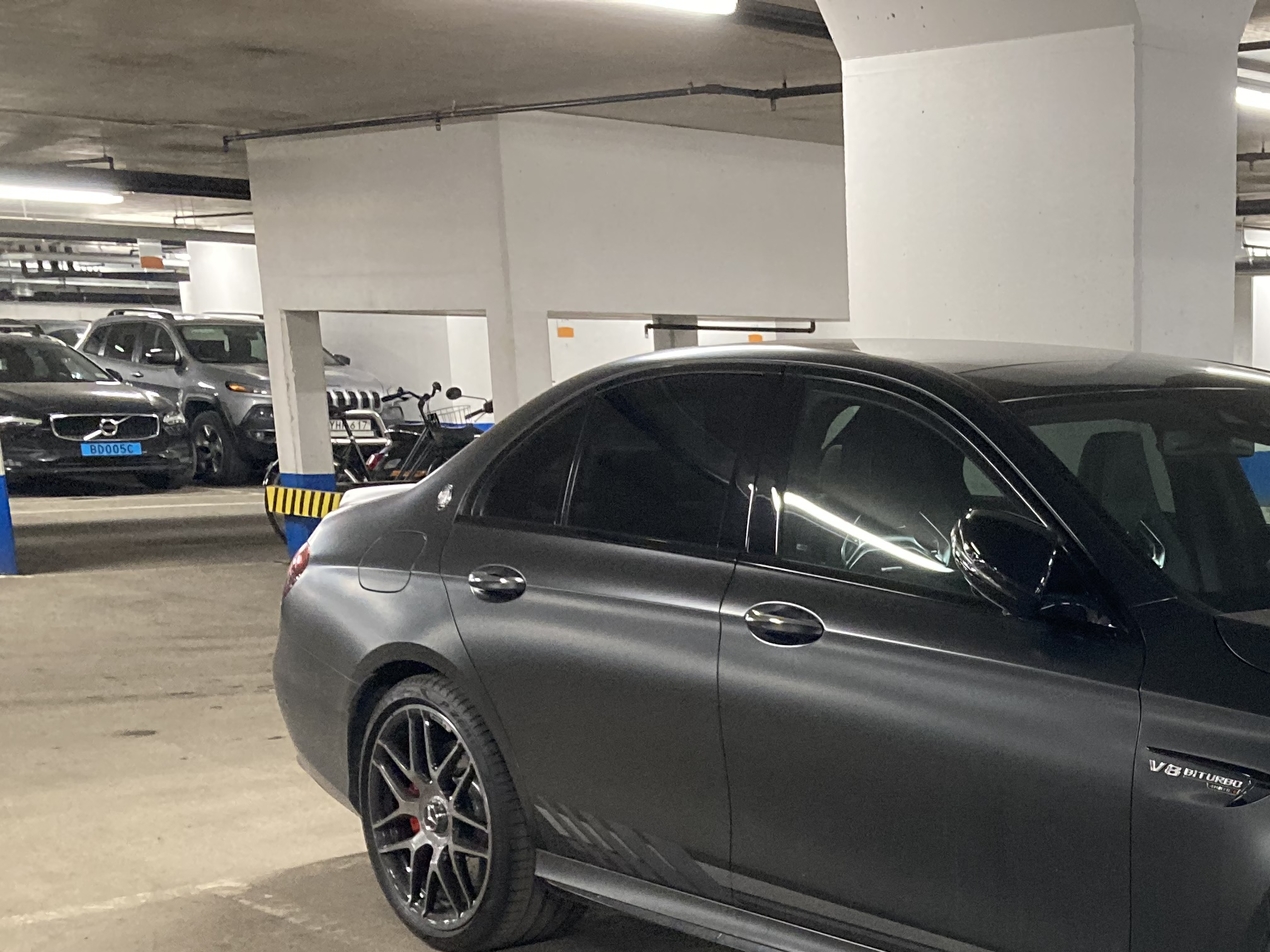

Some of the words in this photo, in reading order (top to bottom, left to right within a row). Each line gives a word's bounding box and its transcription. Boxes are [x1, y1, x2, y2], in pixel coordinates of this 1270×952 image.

[90, 444, 134, 454] BD005C
[1149, 759, 1182, 777] V8
[1183, 767, 1243, 787] BITURBO
